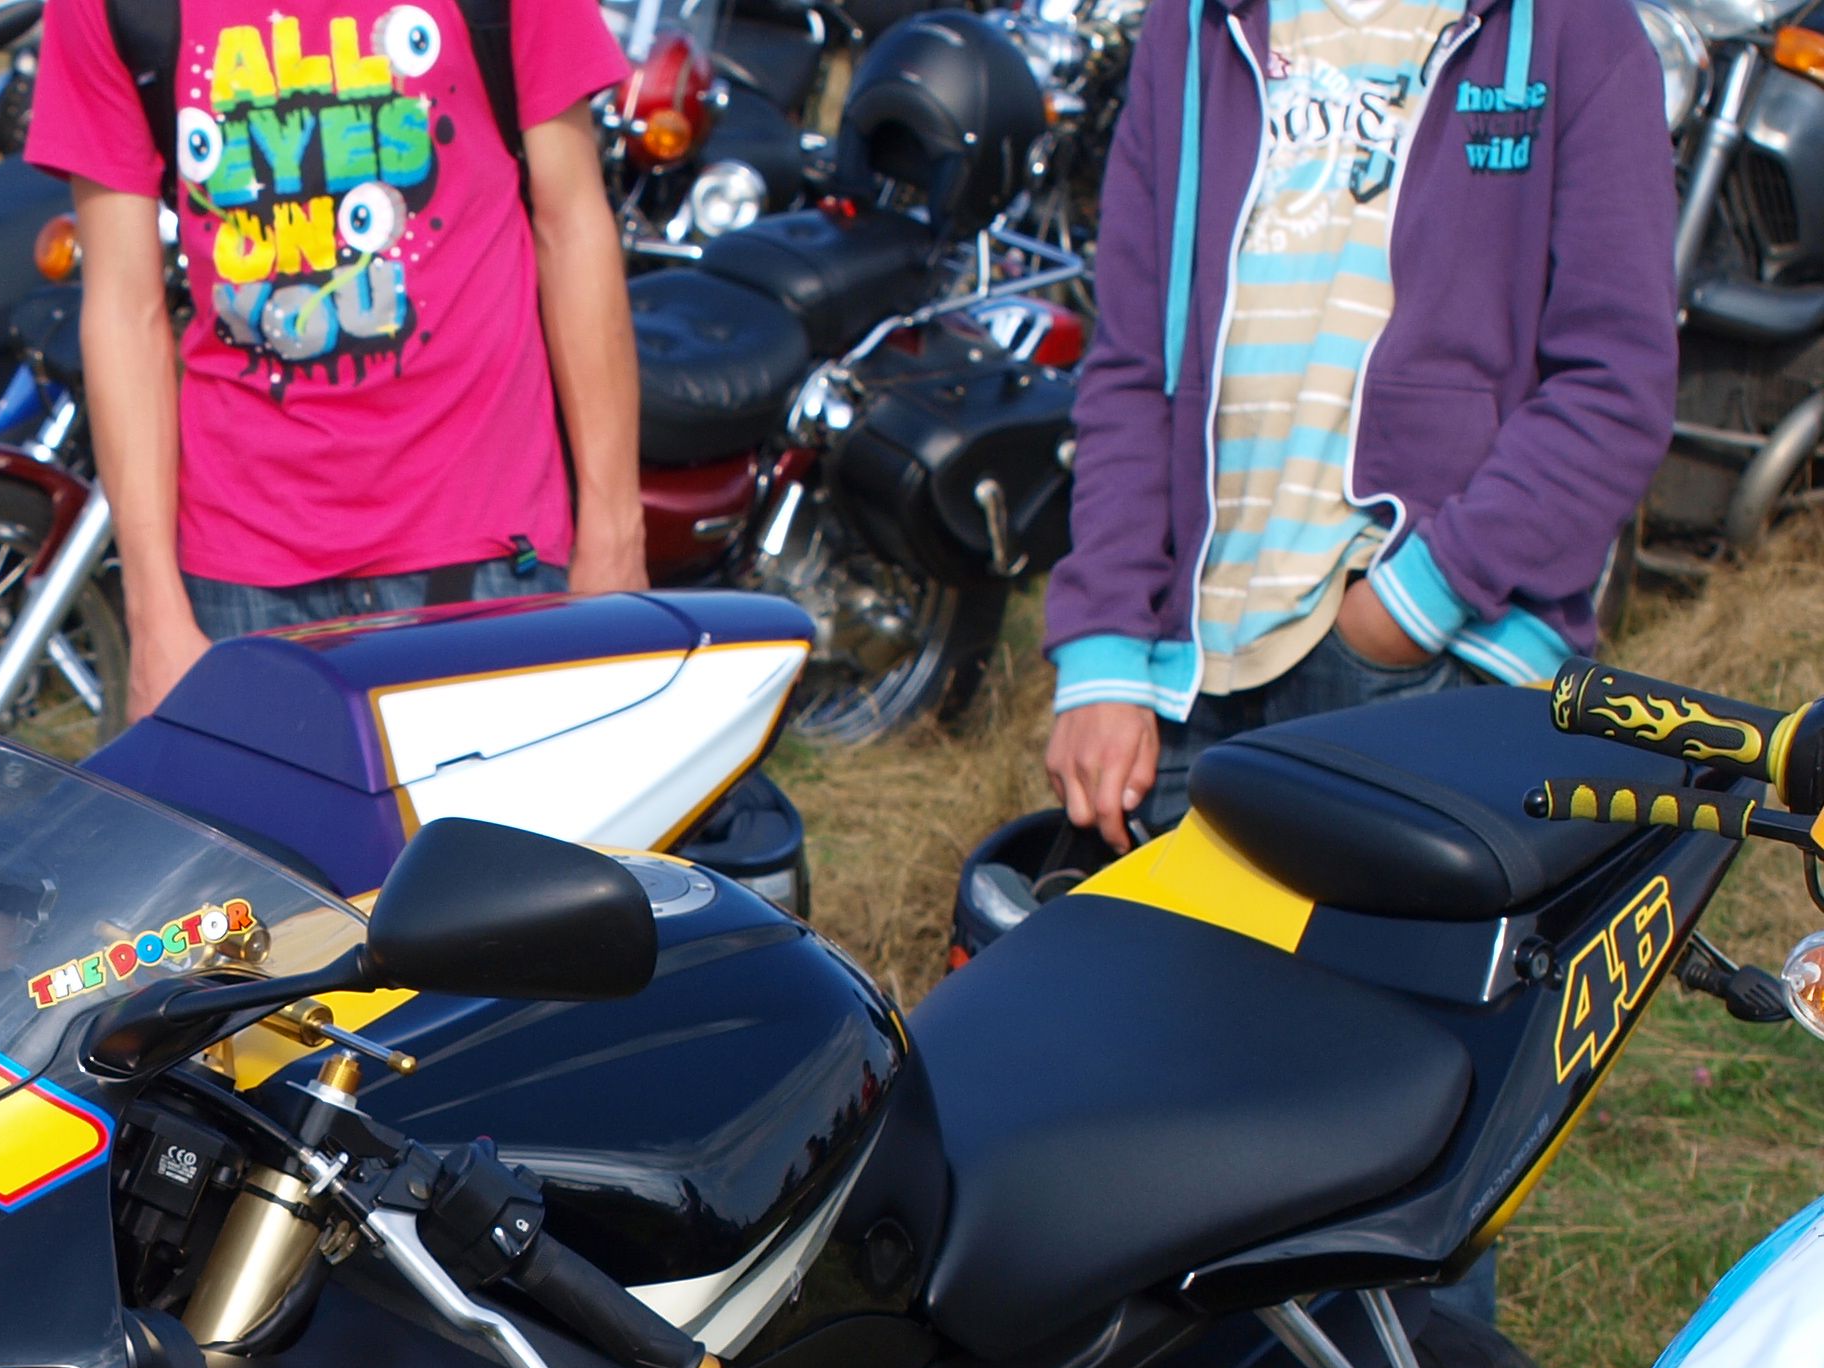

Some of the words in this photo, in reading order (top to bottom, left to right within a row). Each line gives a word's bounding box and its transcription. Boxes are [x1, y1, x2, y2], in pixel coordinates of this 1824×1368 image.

[211, 16, 394, 112] ALL
[207, 97, 431, 206] EYES
[1465, 134, 1531, 170] wild
[213, 196, 337, 284] ON
[212, 260, 408, 360] YOU
[28, 952, 107, 1008] THE
[104, 898, 257, 981] DOCTOR
[1554, 875, 1674, 1085] 46
